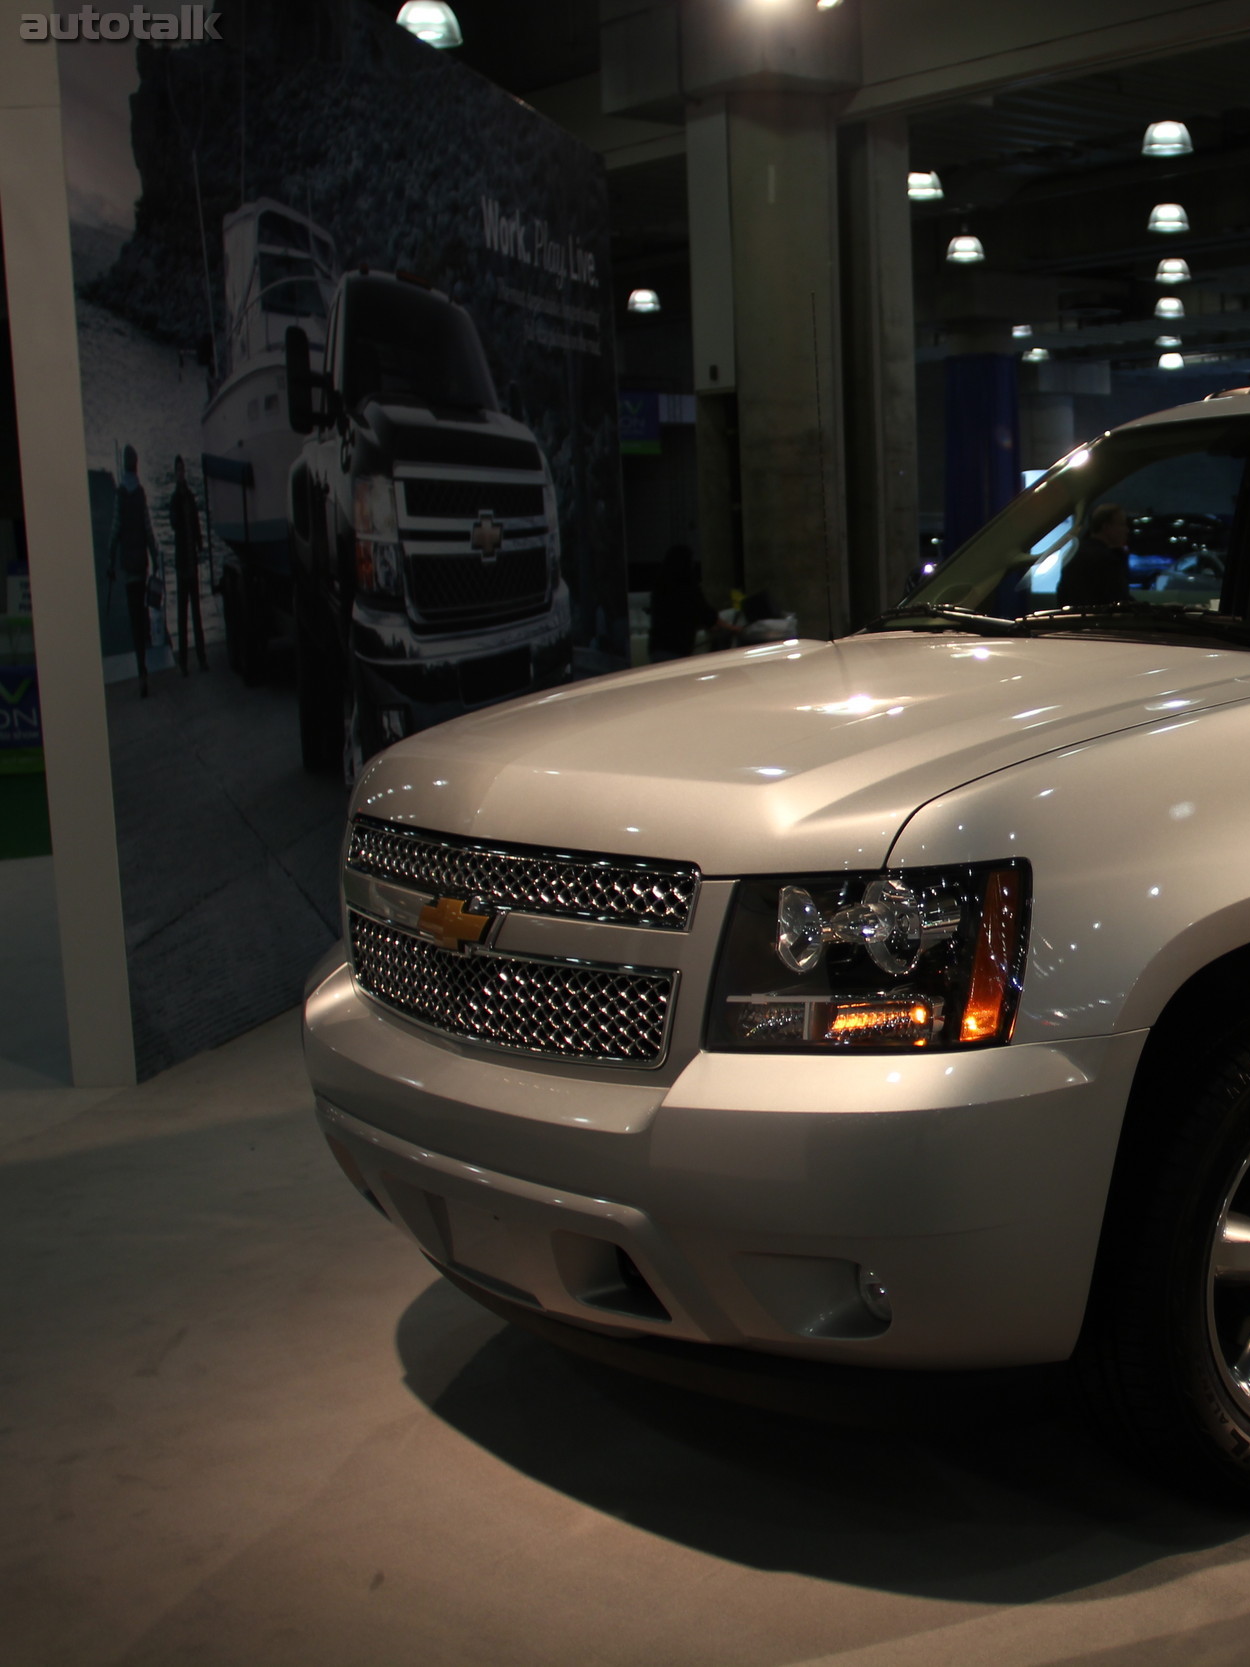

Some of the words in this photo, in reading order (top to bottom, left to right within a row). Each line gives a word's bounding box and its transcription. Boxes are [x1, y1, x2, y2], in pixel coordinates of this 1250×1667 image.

[481, 195, 531, 264] Work.
[534, 218, 568, 291] Play.
[568, 233, 600, 289] Live.
